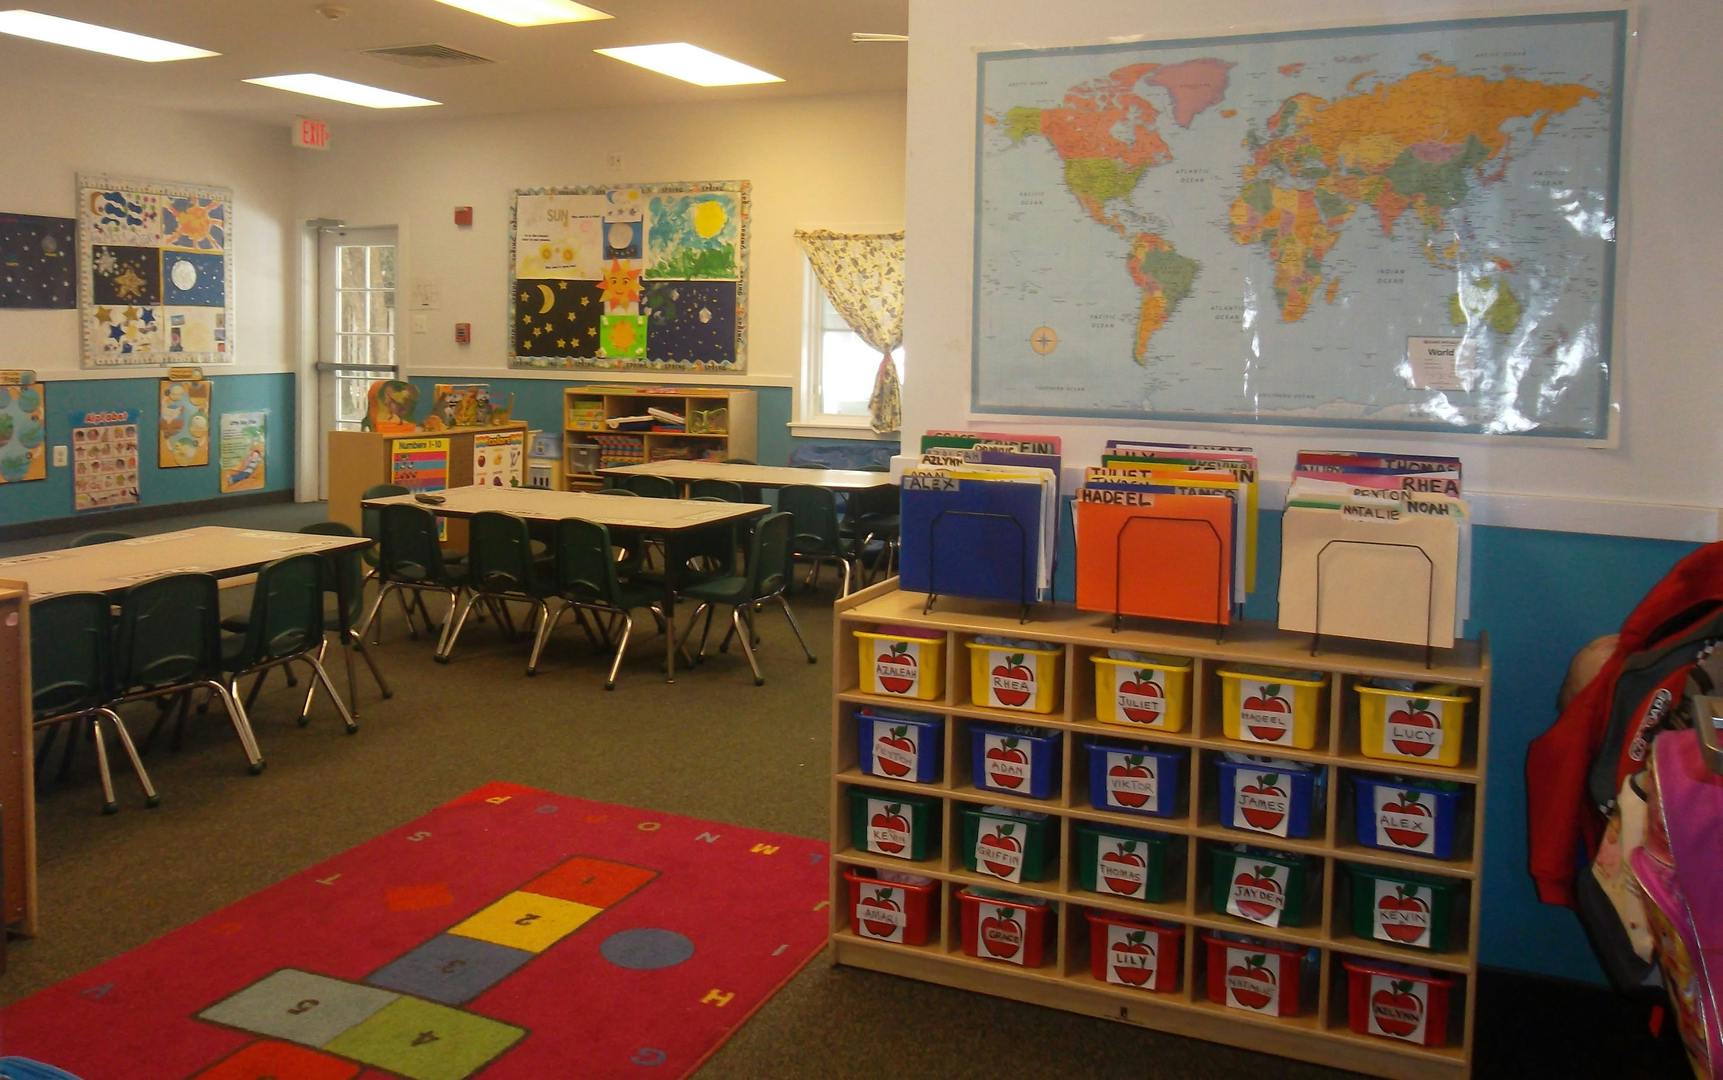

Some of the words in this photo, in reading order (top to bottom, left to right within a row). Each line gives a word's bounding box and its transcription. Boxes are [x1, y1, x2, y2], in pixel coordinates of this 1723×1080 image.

[303, 120, 326, 146] EXIT
[1428, 348, 1455, 357] World
[910, 477, 954, 490] ALEX
[1403, 477, 1459, 494] RHEA
[1082, 489, 1152, 506] HADEEL
[1343, 504, 1400, 520] NATALIE
[1407, 501, 1449, 515] NOAH
[876, 663, 917, 678] AZALEAH
[993, 676, 1029, 691] RHEA
[1118, 695, 1159, 710] JULIET
[1241, 712, 1286, 726] HADEEL
[1393, 727, 1436, 742] LUCY
[991, 760, 1023, 775] ADAN
[1110, 778, 1154, 794] VIKTOR
[1238, 794, 1285, 812] JAMES
[1380, 815, 1423, 831] ALEX
[873, 829, 906, 844] KEVIN
[978, 847, 1019, 865] GRIFFIN
[1100, 864, 1141, 882] THOMAS
[1234, 886, 1283, 906] JAYDEN
[514, 912, 544, 927] 2
[1115, 953, 1148, 968] LILY
[287, 999, 321, 1016] 5
[410, 1029, 440, 1048] 4
